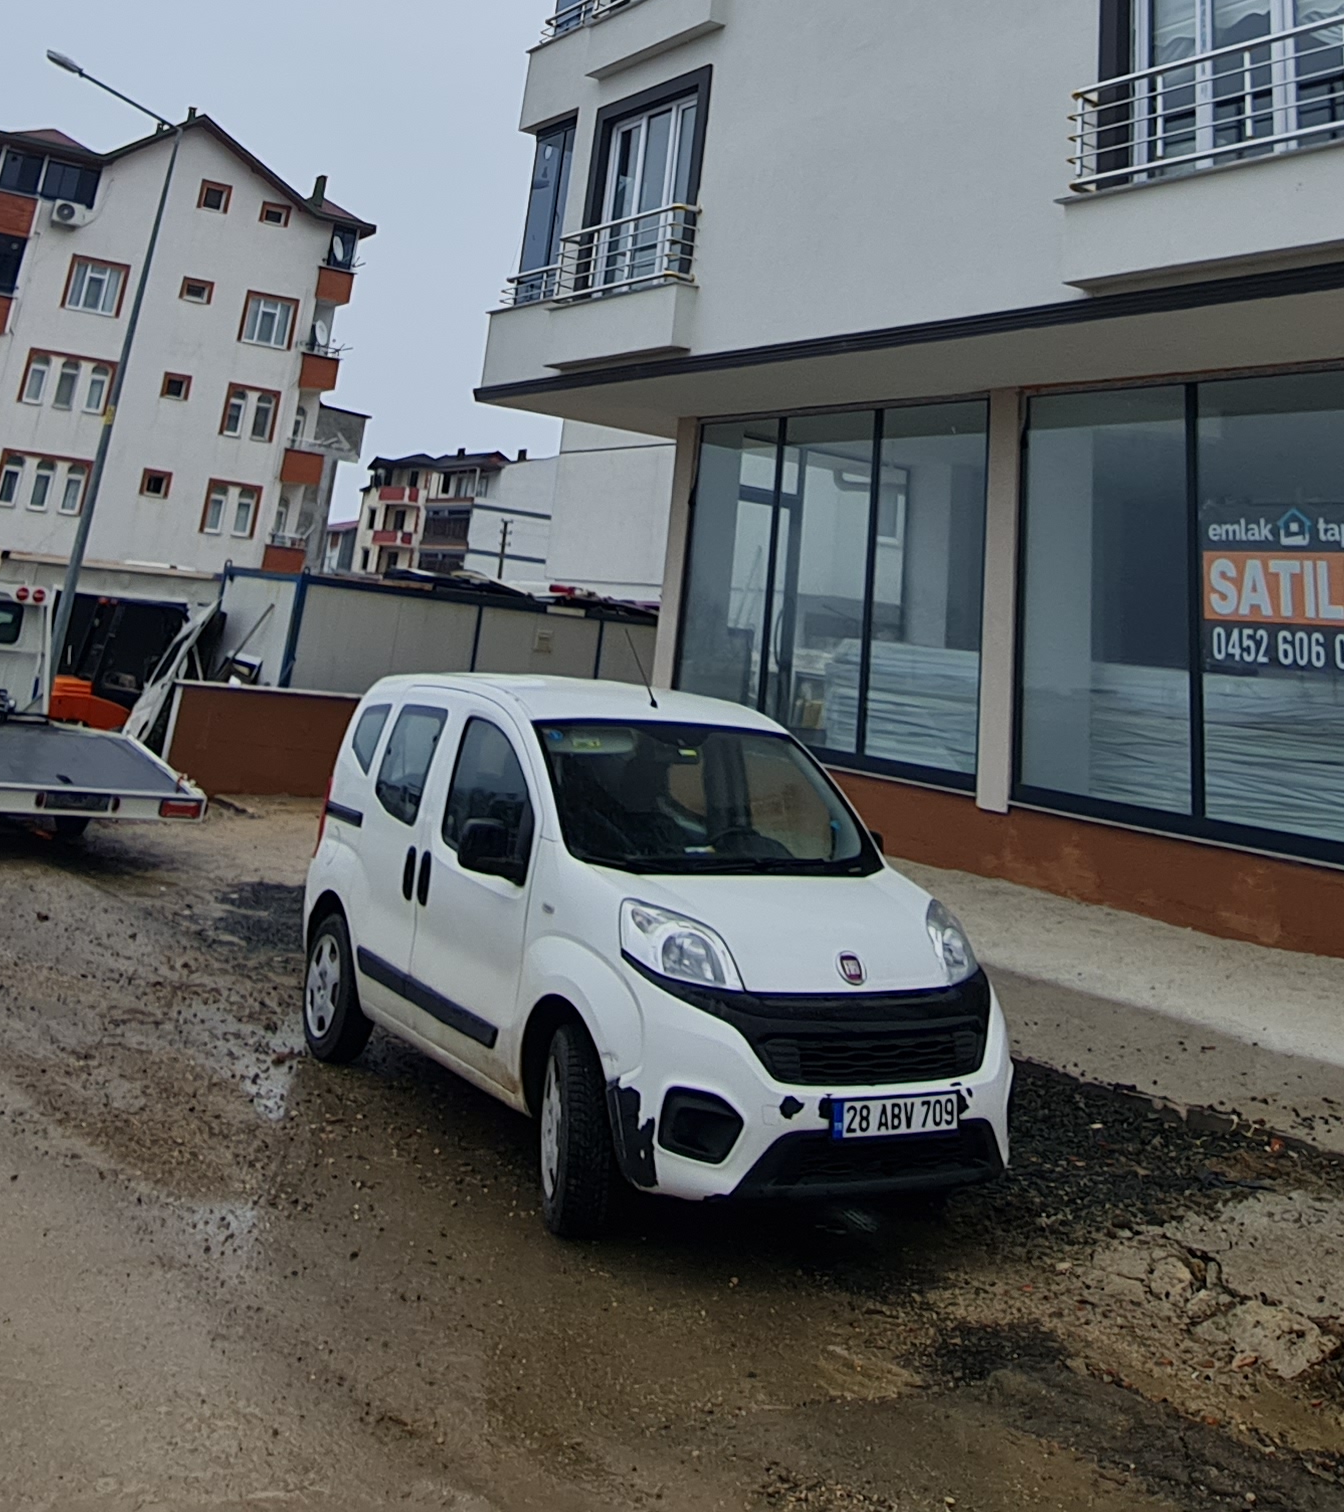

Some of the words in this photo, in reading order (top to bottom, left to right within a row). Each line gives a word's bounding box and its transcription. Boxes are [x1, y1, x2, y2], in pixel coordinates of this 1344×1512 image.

[1208, 517, 1274, 541] emlak
[1212, 627, 1269, 664] 0452
[1277, 630, 1326, 668] 606
[845, 1104, 871, 1134] 28
[877, 1101, 915, 1131] ABV
[921, 1098, 955, 1128] 709
